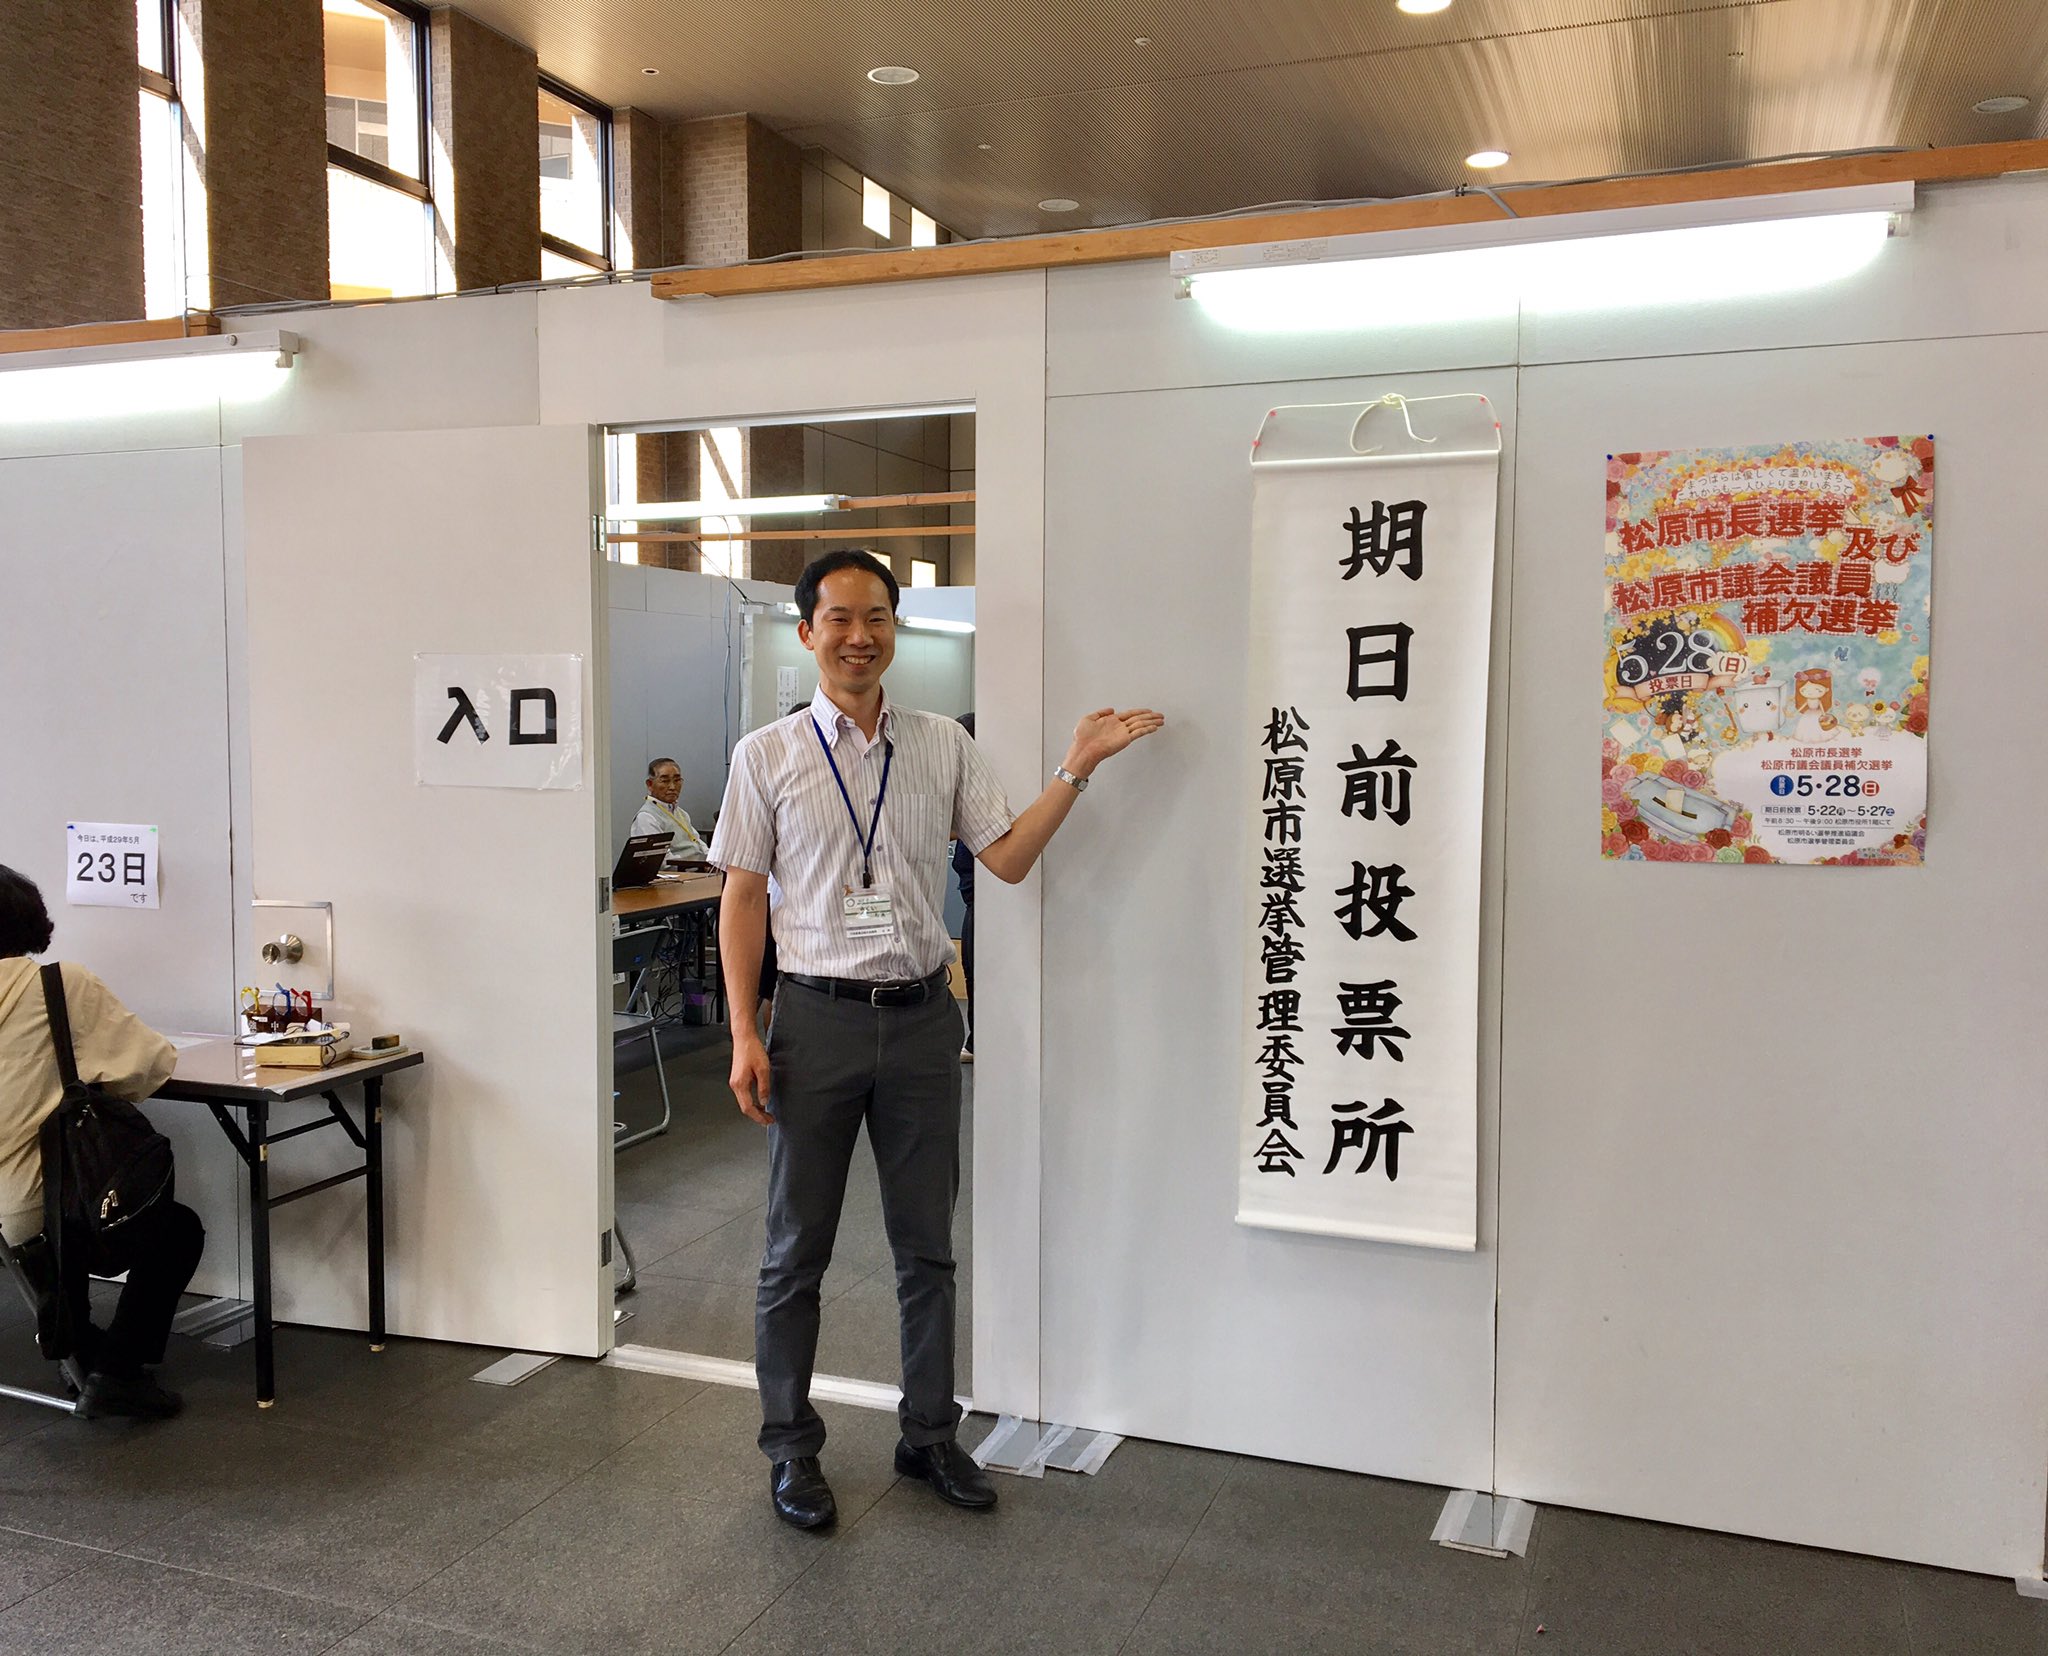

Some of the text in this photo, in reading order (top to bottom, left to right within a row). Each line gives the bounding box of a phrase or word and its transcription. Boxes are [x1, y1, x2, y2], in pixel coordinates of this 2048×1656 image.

[1619, 501, 1921, 563] 松原市長選挙 及び
[1612, 561, 1873, 615] 松原市議会議員
[1740, 599, 1900, 636] 補欠選挙
[1649, 675, 1692, 693] 投票日
[436, 686, 558, 746] 入口
[1761, 759, 1893, 771] 松原市議会議員補欠選挙
[1790, 747, 1862, 759] 松原市長選挙
[1322, 499, 1428, 1183] 期日前投票所
[76, 852, 145, 886] 23日
[130, 893, 147, 904] です
[1253, 705, 1310, 1178] 松原市選挙管理委員会
